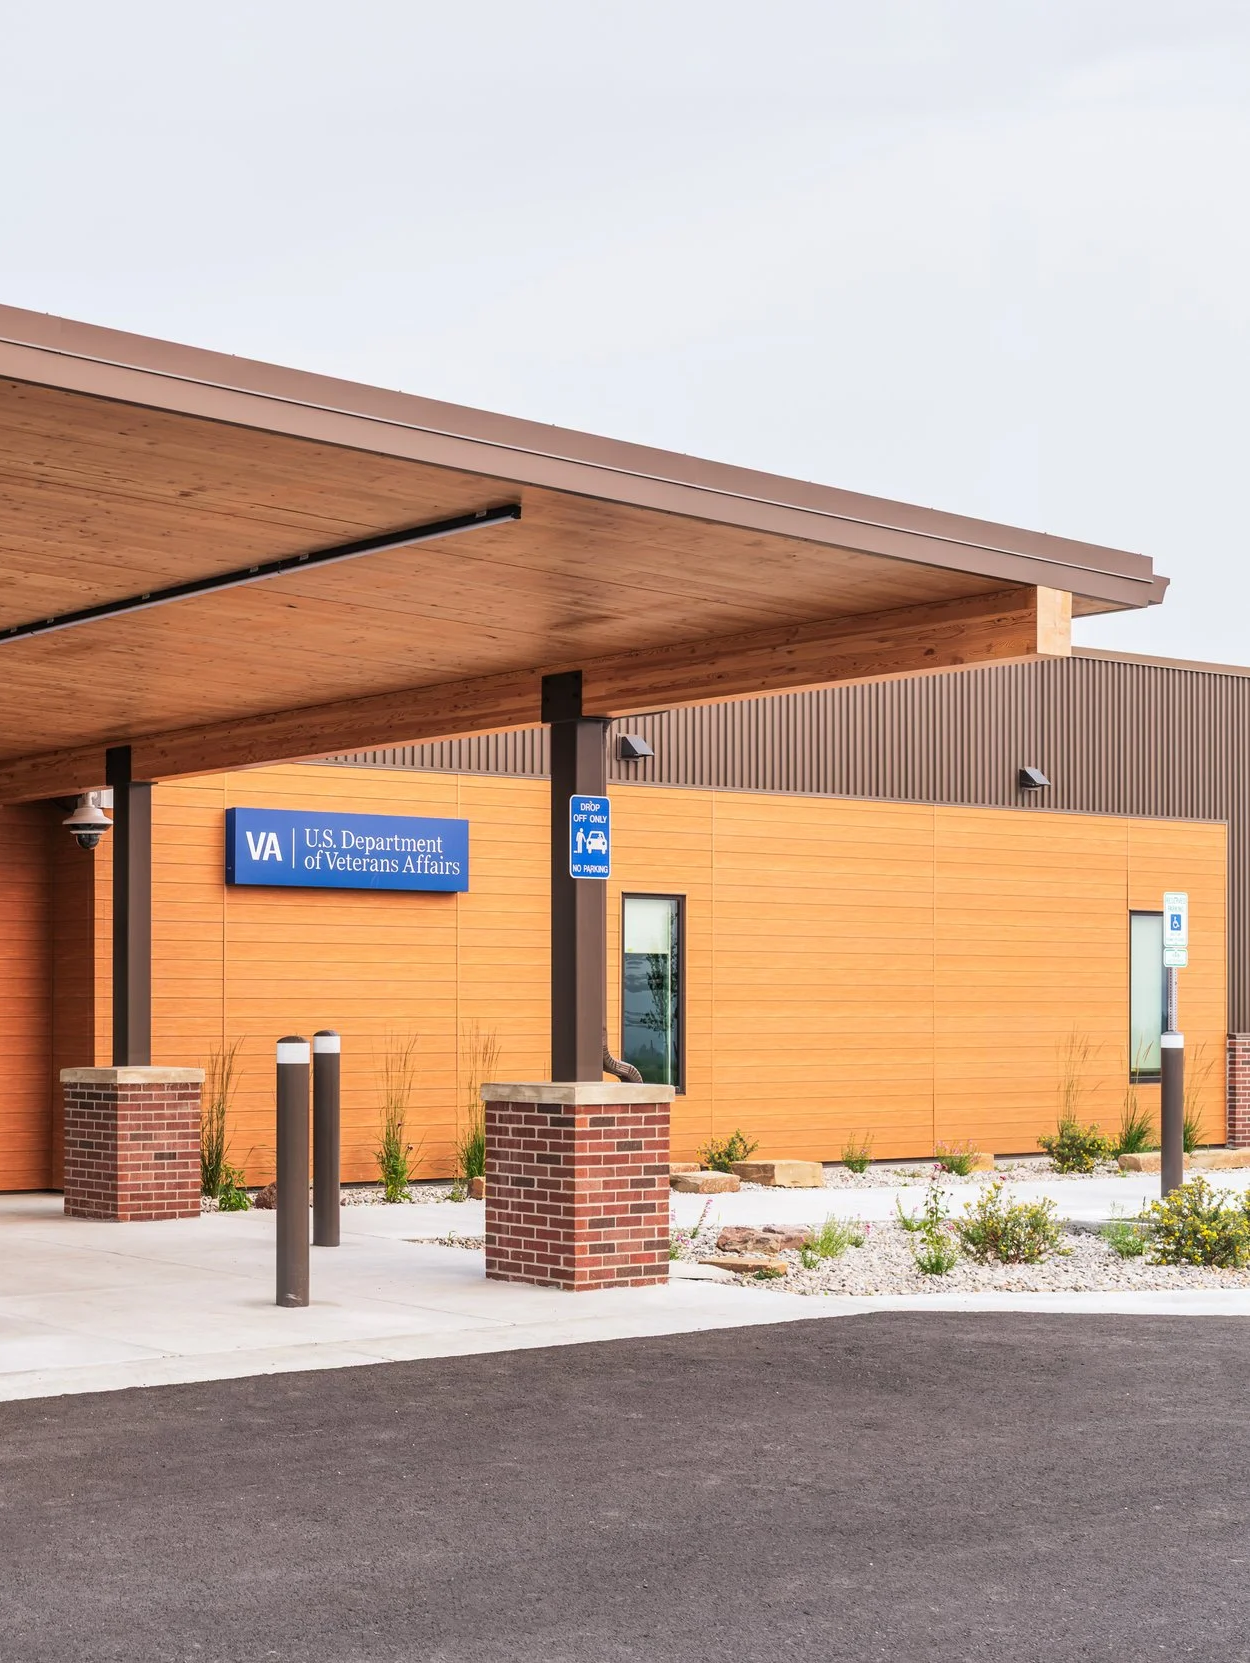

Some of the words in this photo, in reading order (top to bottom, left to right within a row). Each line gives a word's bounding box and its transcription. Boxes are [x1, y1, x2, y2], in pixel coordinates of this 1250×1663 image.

[580, 803, 600, 811] DROP
[573, 814, 587, 822] OFF
[590, 815, 607, 823] ONLY
[246, 831, 282, 862] VA
[304, 828, 336, 849] U.S.
[341, 830, 443, 855] Department
[304, 850, 322, 870] of
[325, 851, 399, 873] Veterans
[402, 854, 460, 875] Affairs
[573, 864, 581, 872] NO
[583, 865, 608, 873] PARKING
